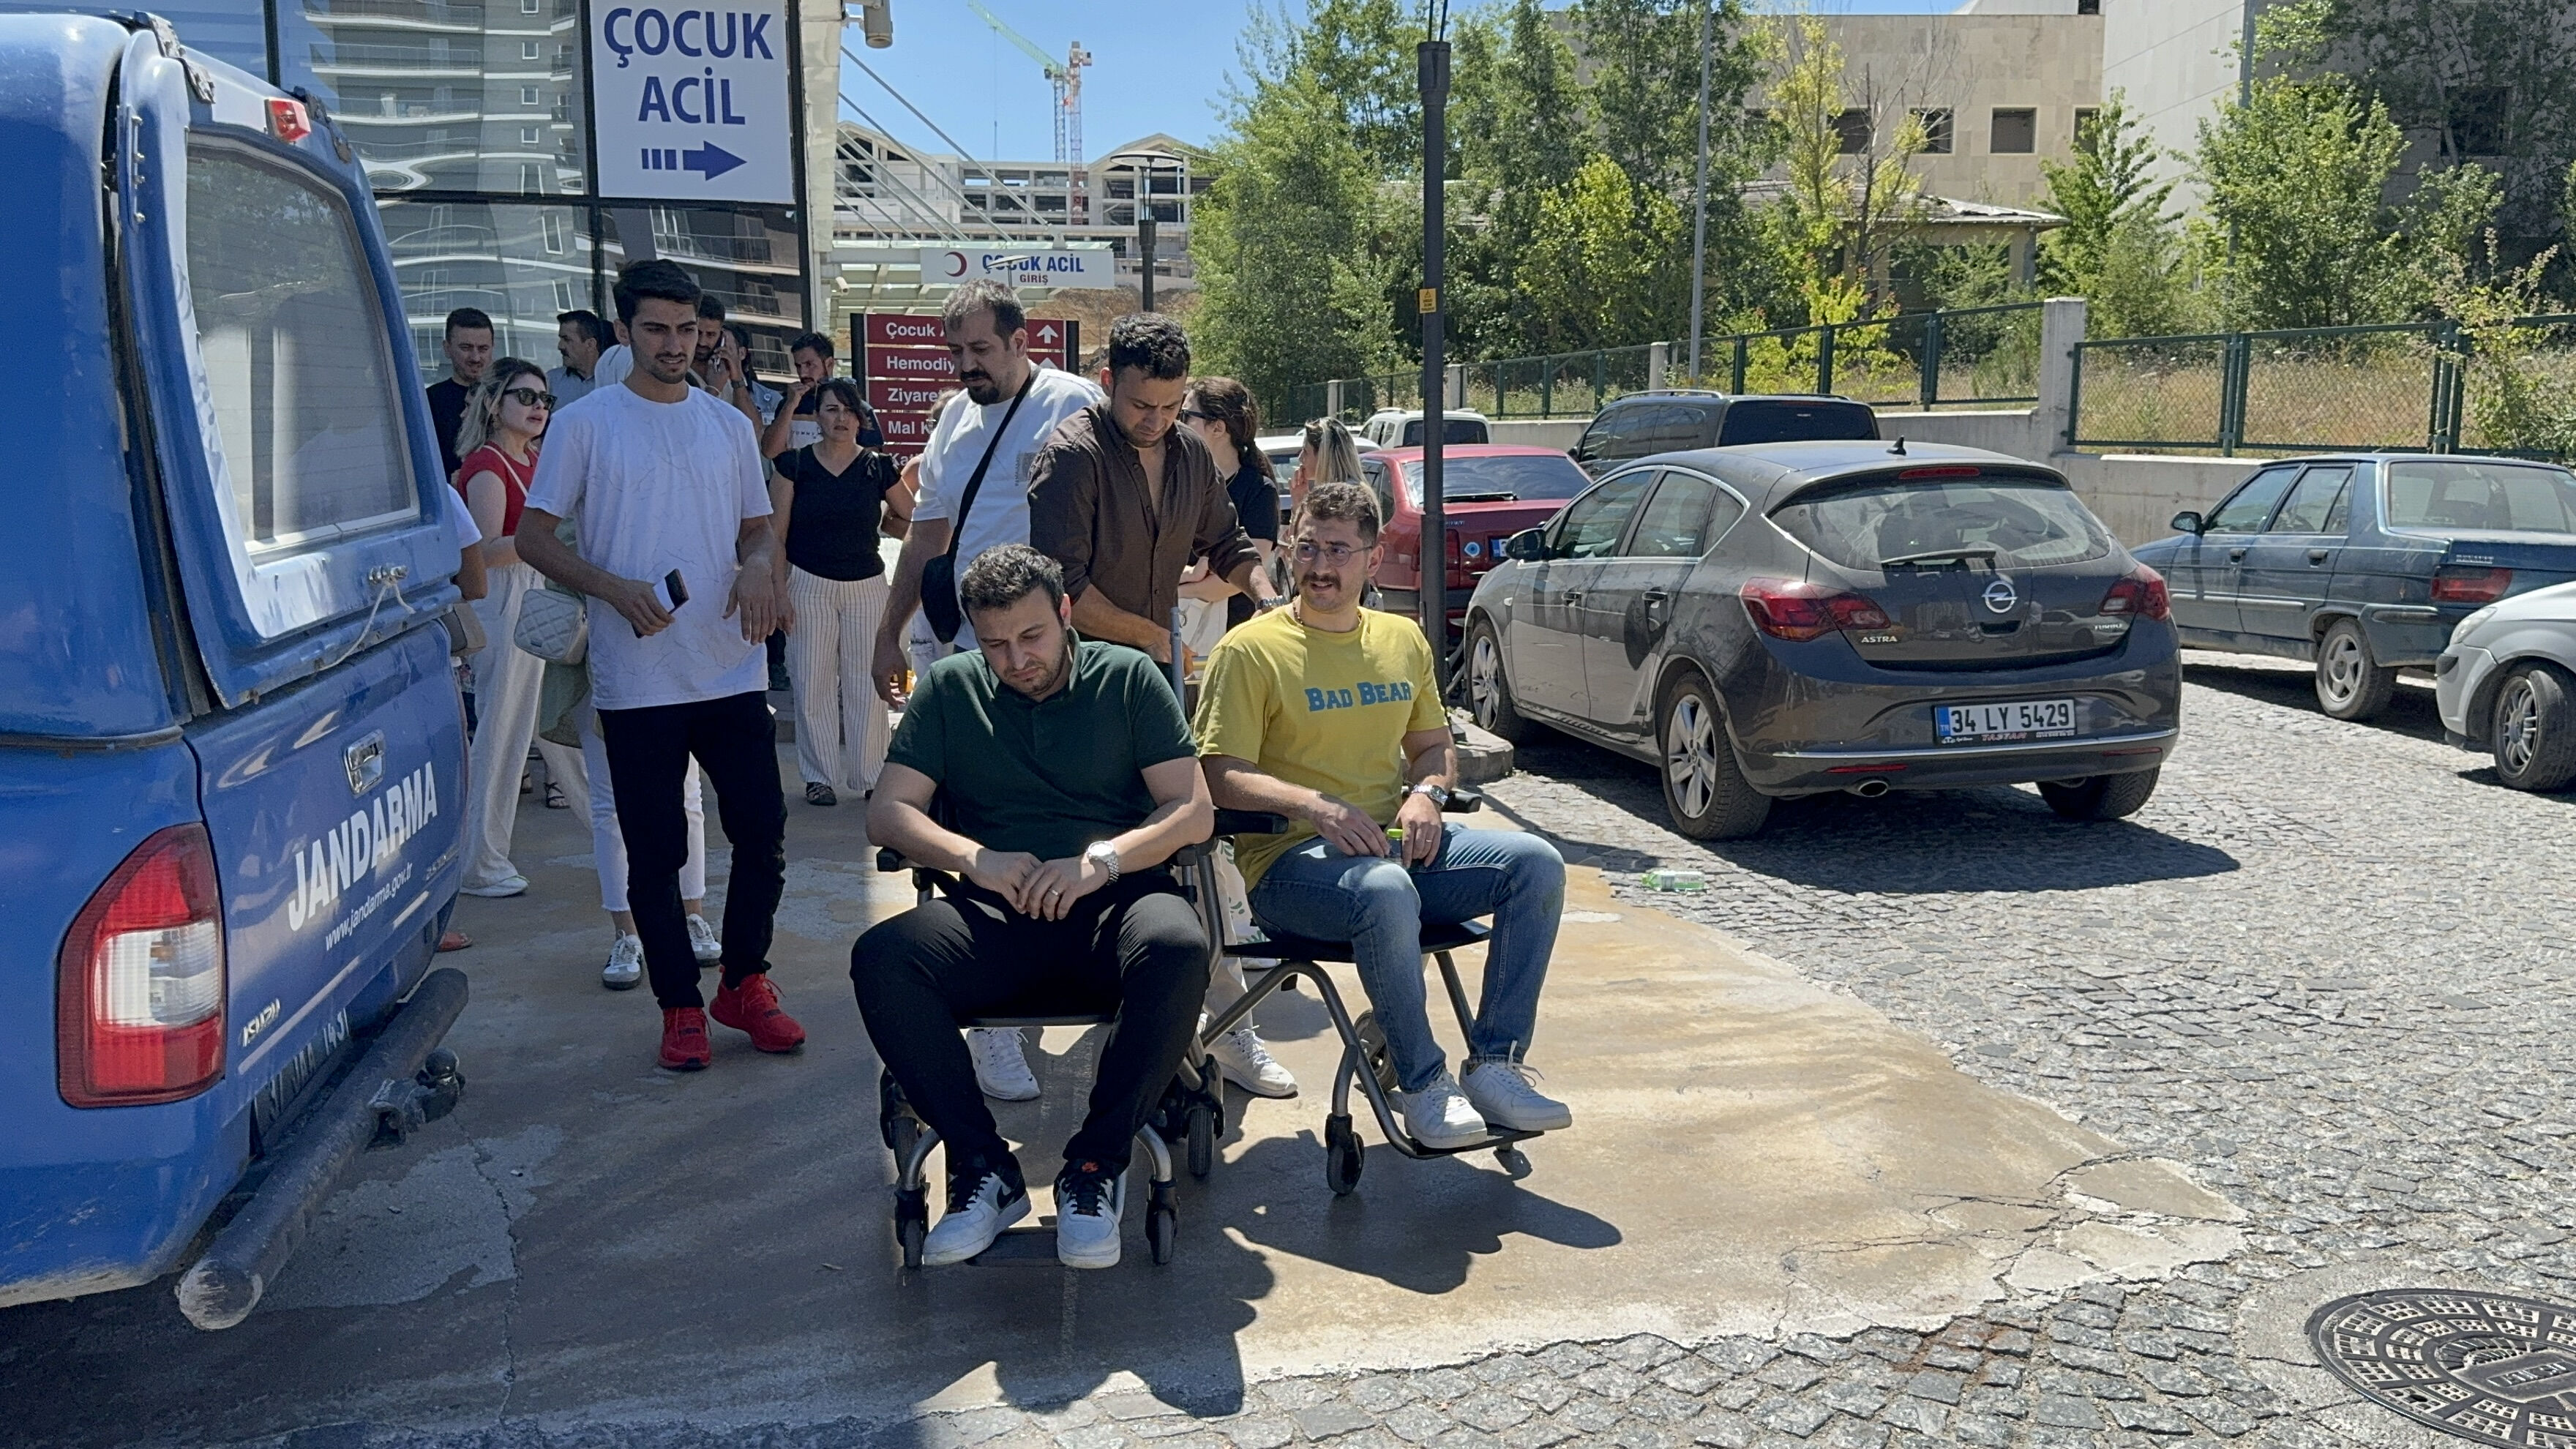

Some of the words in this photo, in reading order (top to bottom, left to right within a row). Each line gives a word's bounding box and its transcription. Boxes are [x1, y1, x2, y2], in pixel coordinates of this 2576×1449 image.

[604, 7, 774, 68] ÇOCUK
[637, 67, 746, 125] ACİL
[1046, 253, 1085, 272] ACİL
[1019, 274, 1049, 285] GİRİŞ
[886, 322, 936, 339] Çocuk
[888, 421, 915, 434] Mal
[1861, 635, 1898, 643] ASTRA
[1951, 709, 1976, 733] 34
[1985, 707, 2008, 730] LY
[2020, 703, 2070, 729] 5429
[288, 761, 438, 932] JANDARMA
[326, 861, 413, 951] www.jandarma.gov.tr
